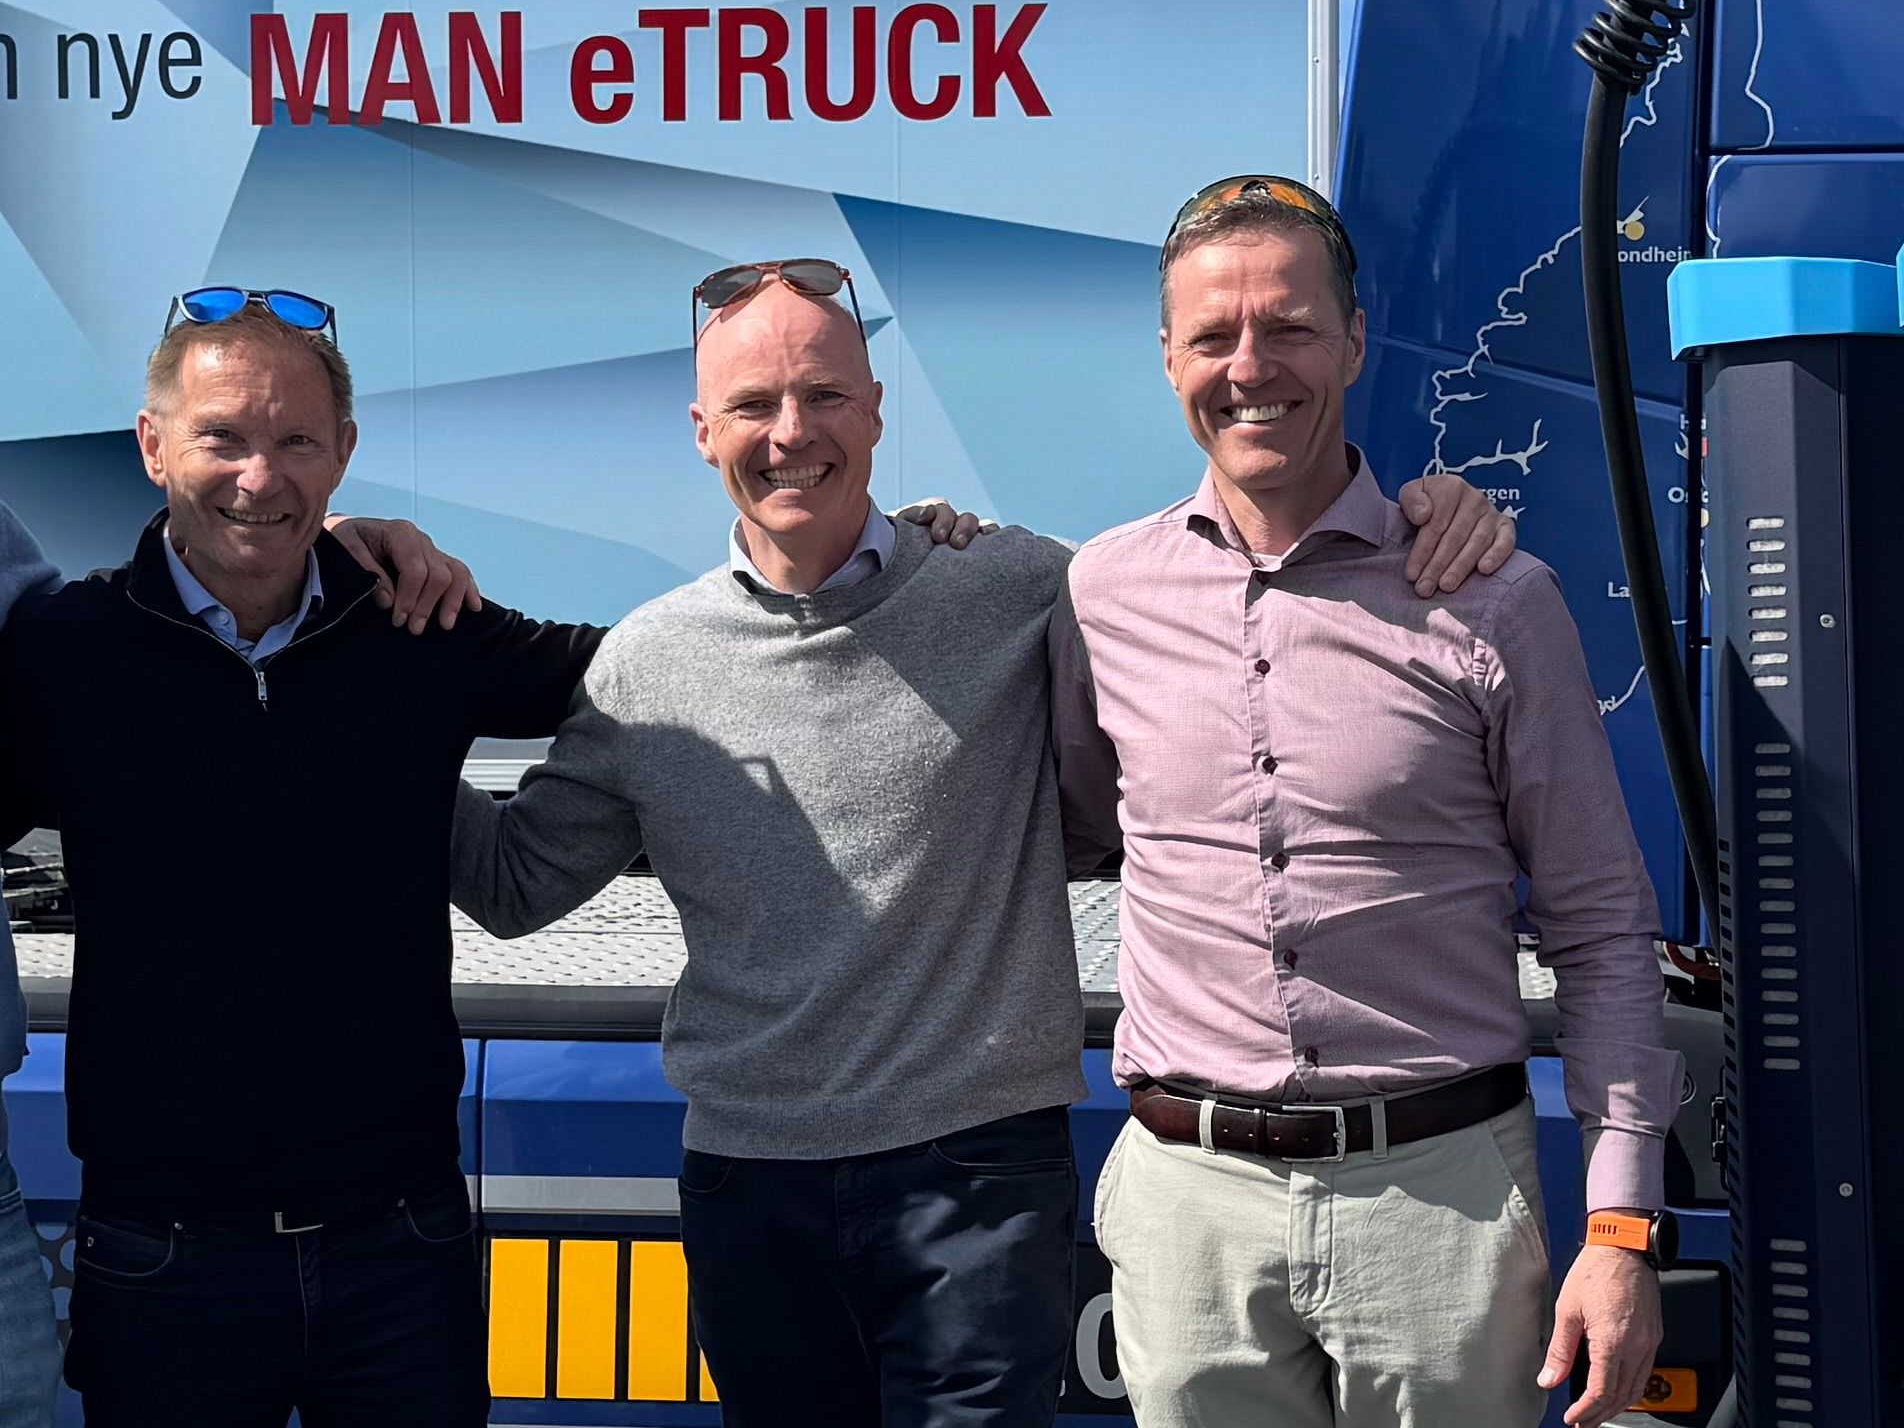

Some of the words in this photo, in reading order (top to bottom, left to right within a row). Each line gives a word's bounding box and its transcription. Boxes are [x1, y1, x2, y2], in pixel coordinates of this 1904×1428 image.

[57, 30, 202, 120] nye
[250, 10, 523, 126] MAN
[570, 3, 1052, 124] eTRUCK
[1618, 246, 1693, 262] ondhei
